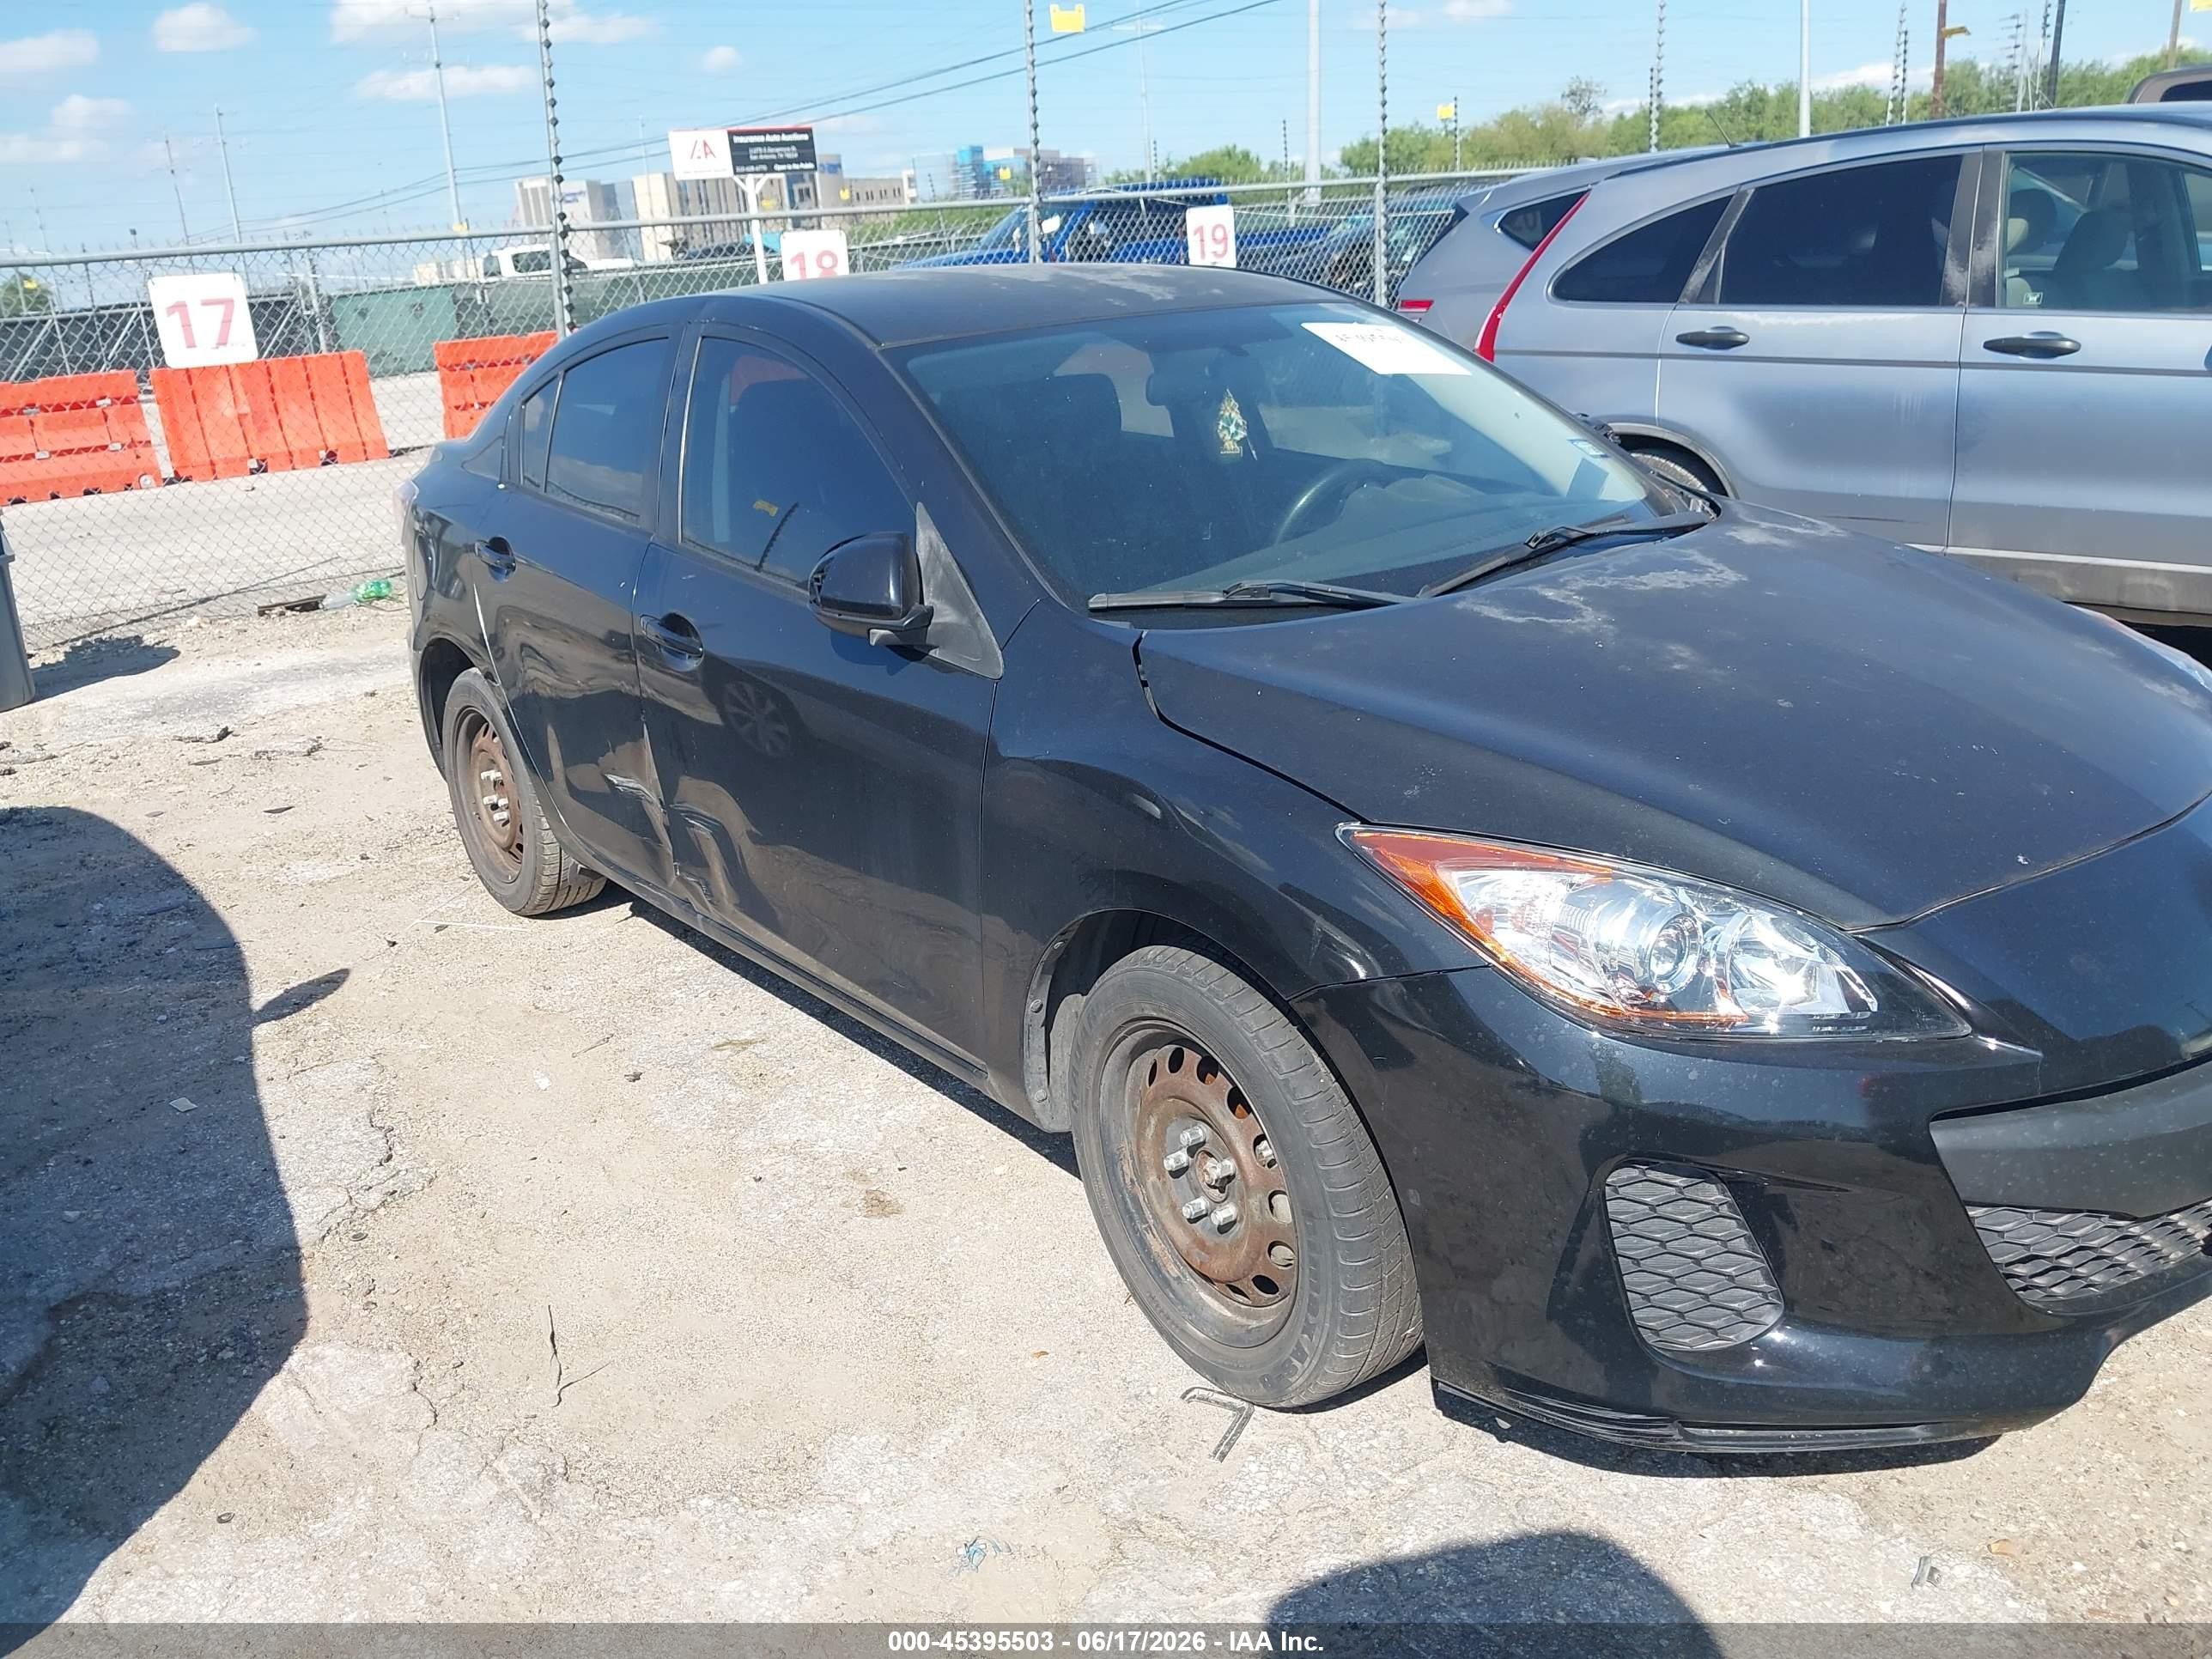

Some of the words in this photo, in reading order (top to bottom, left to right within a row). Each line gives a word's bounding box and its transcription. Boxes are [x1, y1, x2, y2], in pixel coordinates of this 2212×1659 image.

[1193, 224, 1229, 260] 19
[790, 250, 839, 281] 18
[166, 298, 235, 349] 17
